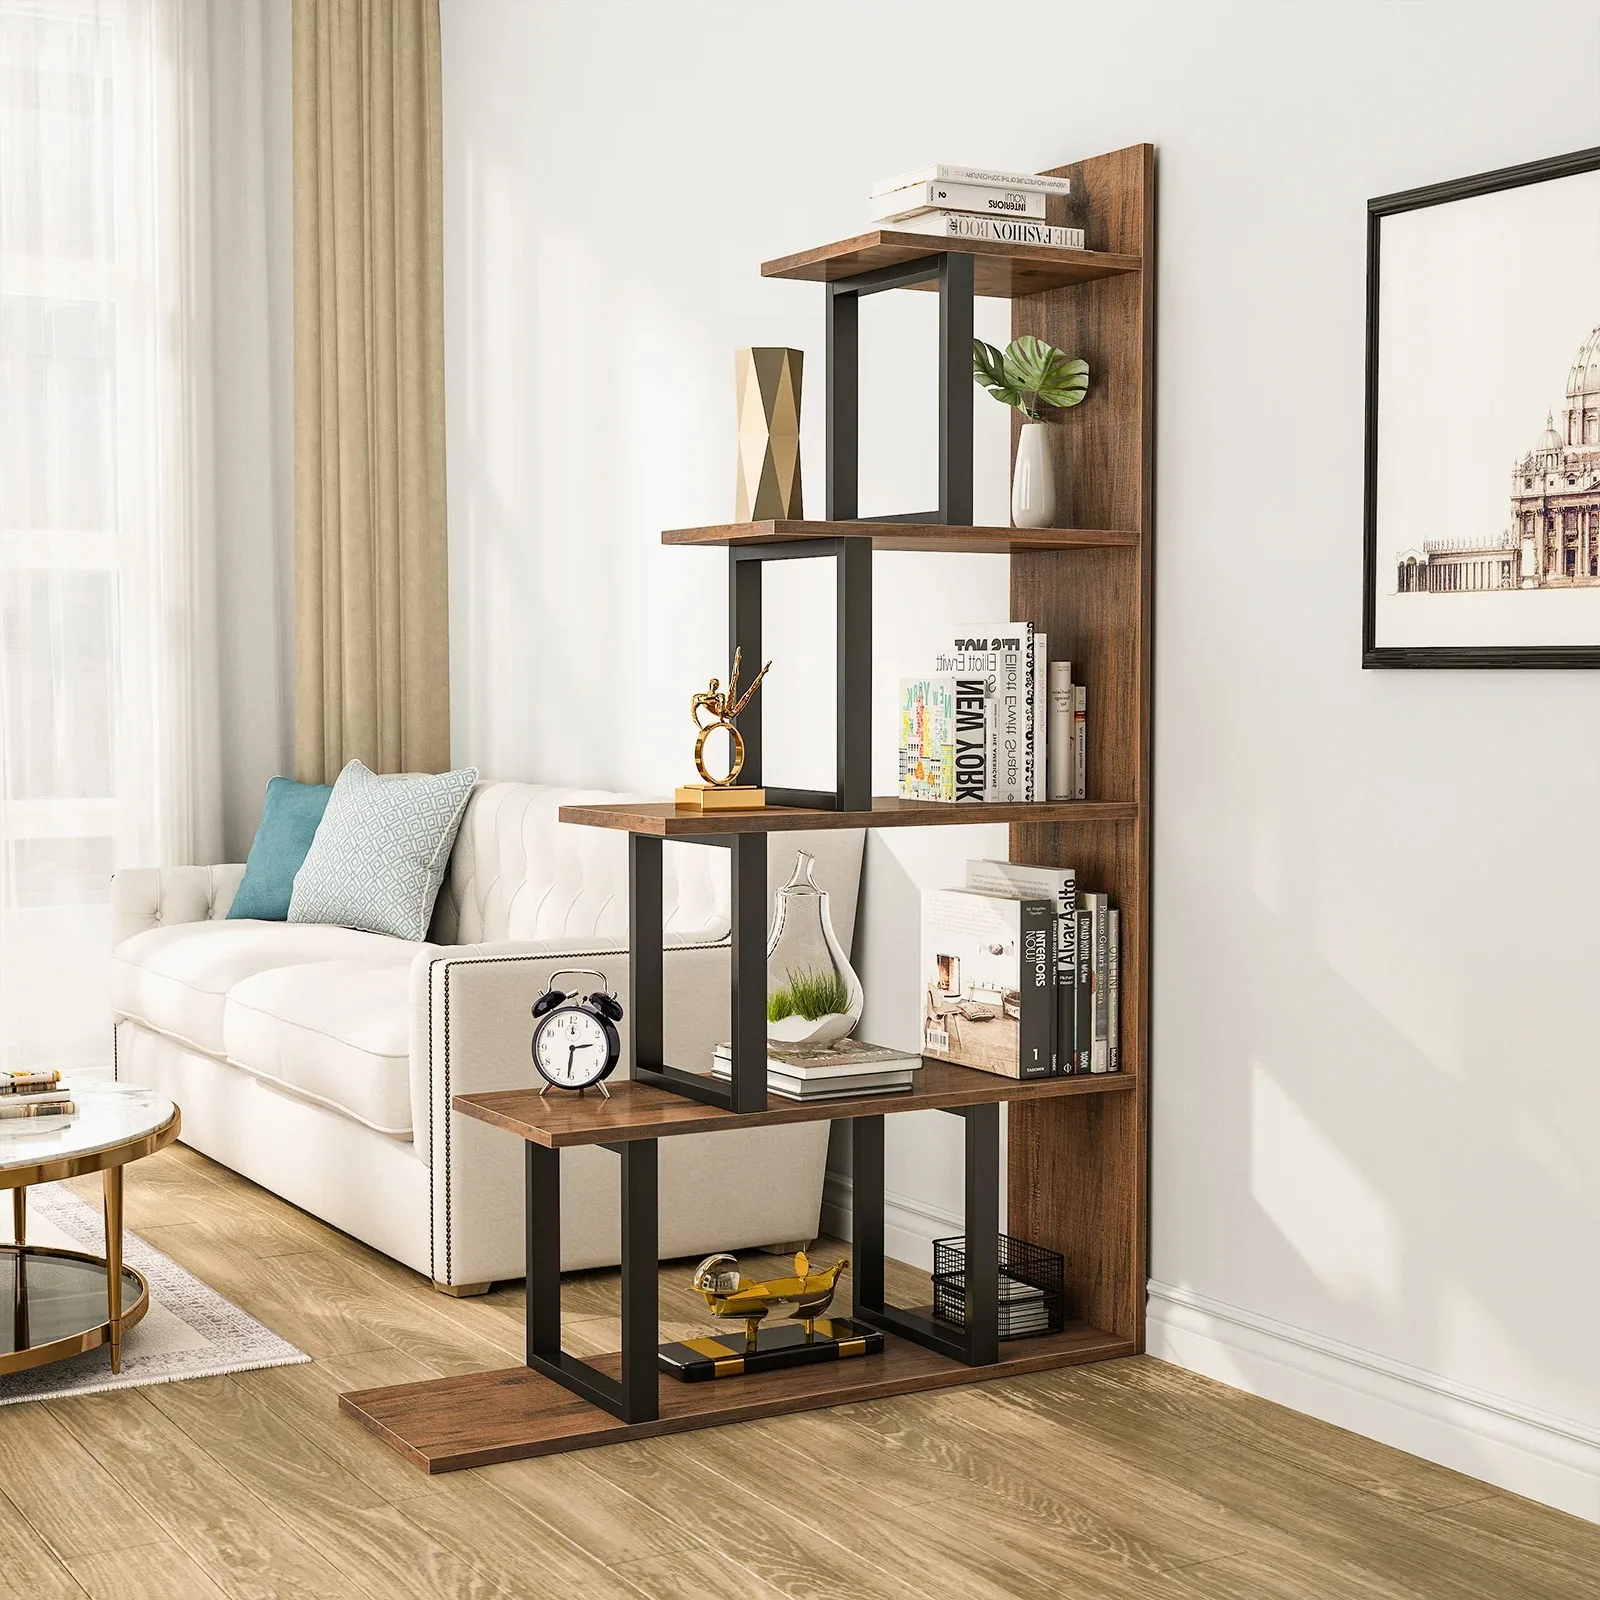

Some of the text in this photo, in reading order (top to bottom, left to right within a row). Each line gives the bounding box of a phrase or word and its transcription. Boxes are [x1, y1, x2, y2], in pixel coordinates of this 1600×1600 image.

[988, 200, 1026, 212] INTERIORS
[949, 218, 988, 238] BOOK
[992, 222, 1052, 244] FASHION
[1054, 229, 1082, 248] THE
[1058, 879, 1076, 964] Alvar Aalto
[1080, 918, 1090, 939] EDWARD
[1098, 905, 1107, 934] Picasso
[1026, 930, 1036, 963] NOW!
[1080, 940, 1089, 960] HOPPER
[1098, 936, 1107, 967] Guitars
[1109, 947, 1118, 963] ON
[1036, 930, 1046, 986] INTERIORS
[1109, 969, 1118, 993] LINE
[558, 1020, 564, 1028] 11
[569, 1016, 578, 1024] 12
[595, 1030, 600, 1039] 2
[542, 1043, 547, 1051] 9
[599, 1045, 604, 1053] 3
[1033, 1048, 1038, 1060] 1
[556, 1068, 561, 1076] 7
[585, 1069, 590, 1077] 5
